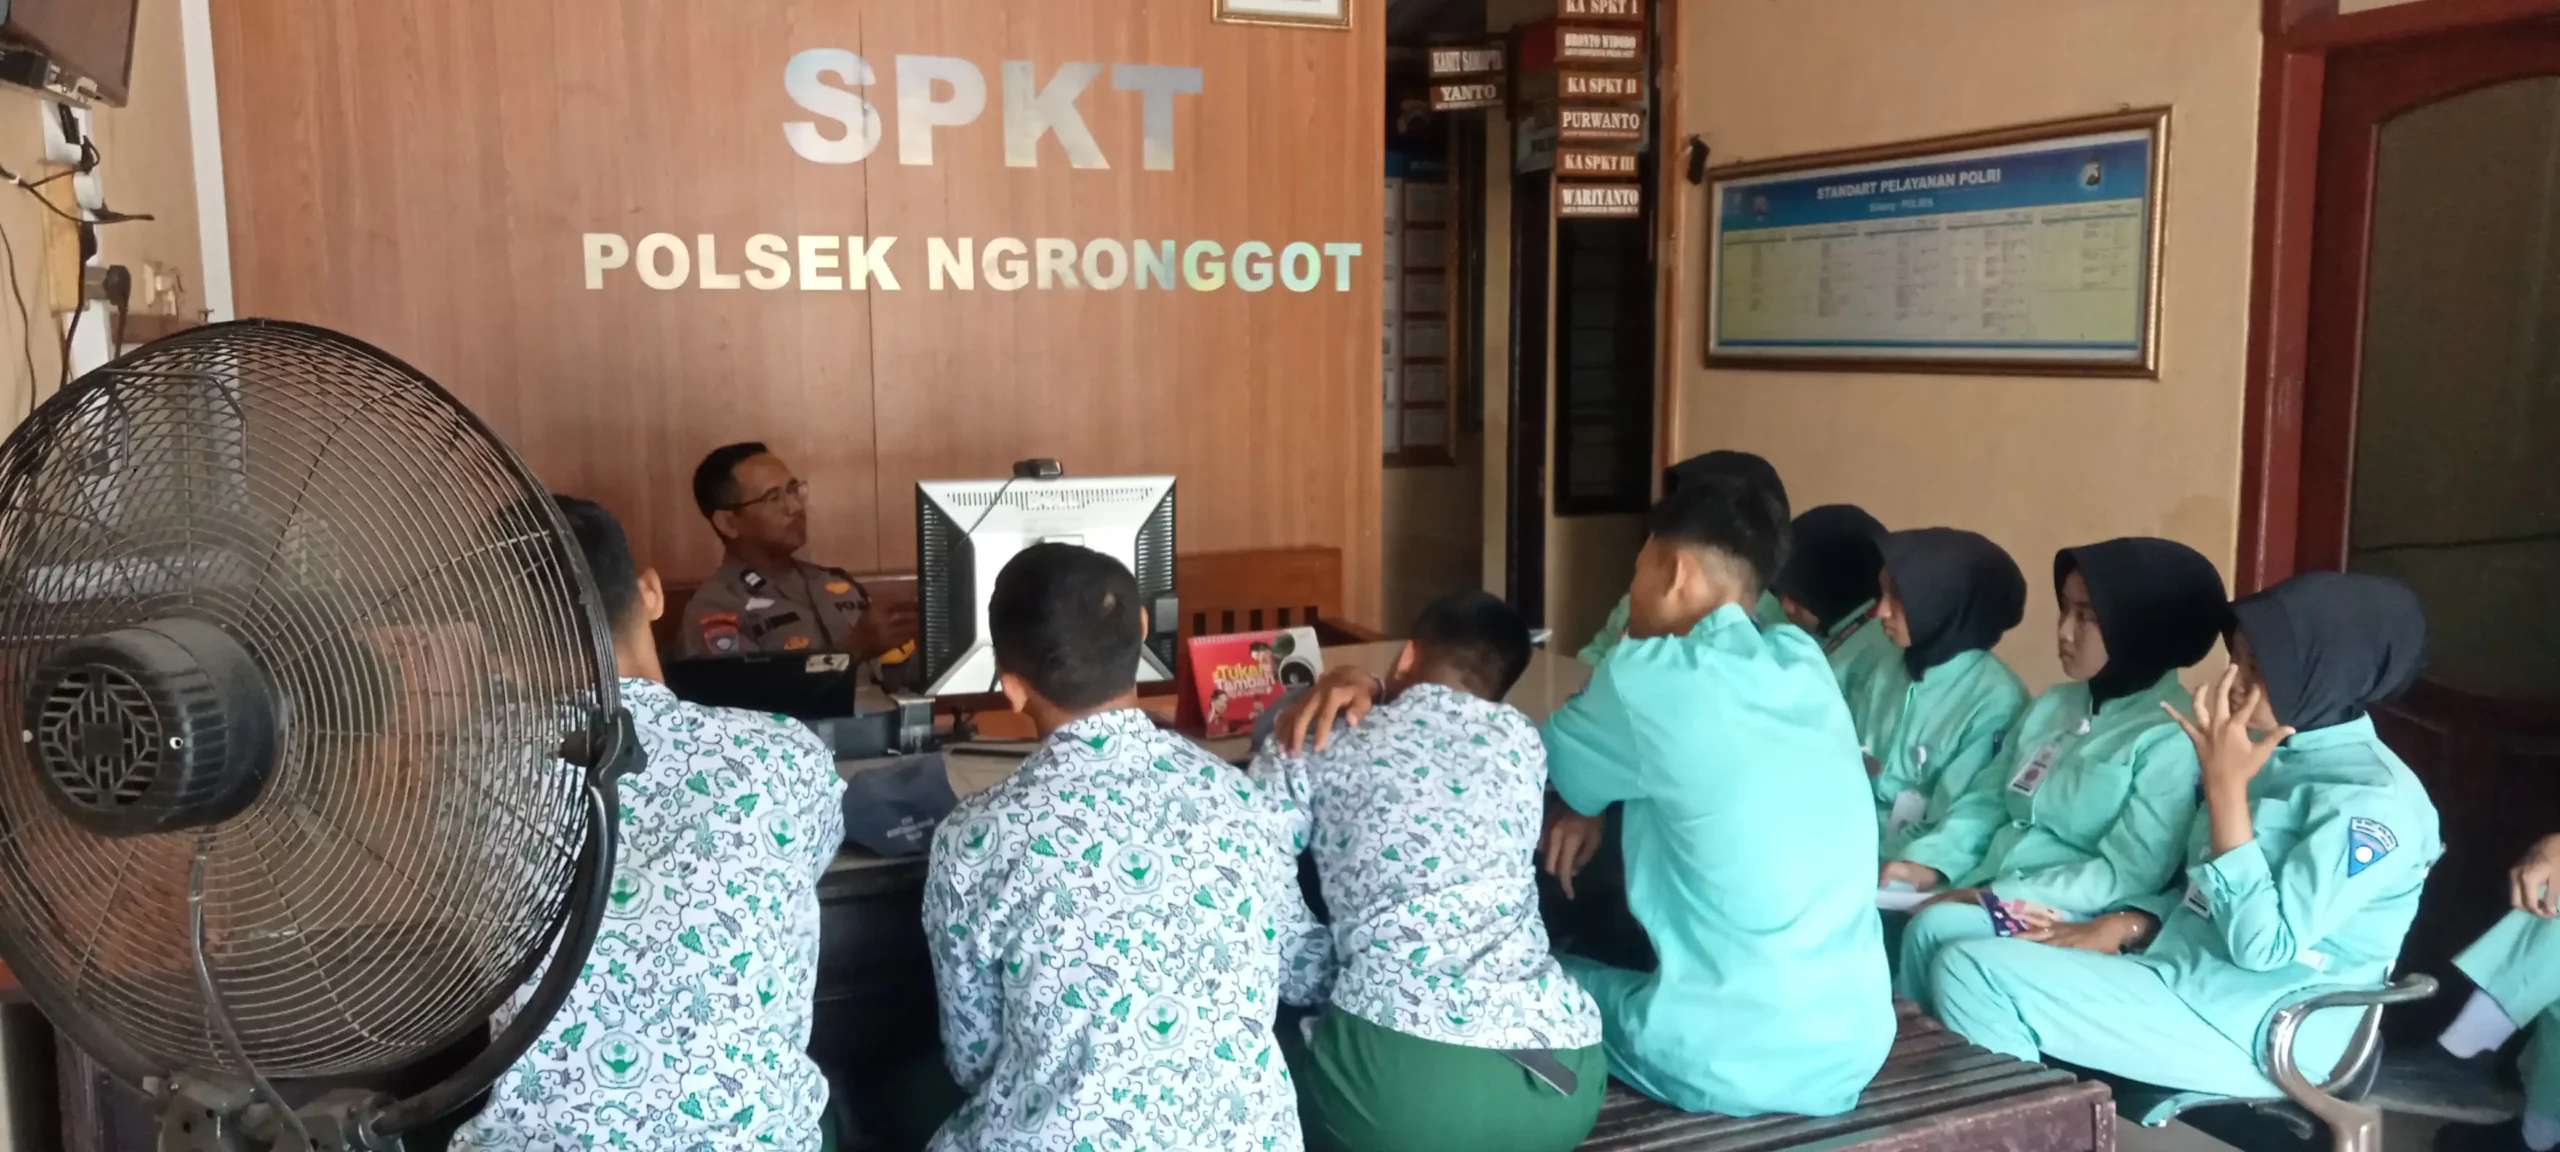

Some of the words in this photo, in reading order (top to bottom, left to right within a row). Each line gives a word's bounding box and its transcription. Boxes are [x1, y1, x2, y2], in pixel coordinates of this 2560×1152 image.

[1566, 0, 1585, 13] KA
[1590, 0, 1626, 14] SPKT
[1632, 0, 1638, 14] I
[1440, 84, 1497, 101] YANTO
[1567, 77, 1586, 93] KA
[1588, 78, 1623, 94] SPKT
[1626, 78, 1637, 94] II
[783, 47, 1204, 172] SPKT
[1562, 111, 1640, 129] PURWANTO
[1564, 154, 1583, 169] KA
[1584, 155, 1618, 170] SPKT
[1620, 156, 1635, 171] III
[1816, 181, 1876, 200] STANDART
[1880, 173, 1956, 194] PELAYANAN
[1959, 168, 2001, 186] POLRI
[1562, 189, 1639, 205] WARIYANTO
[583, 232, 901, 292] POLSEK
[927, 236, 1362, 293] NGRONGGOT
